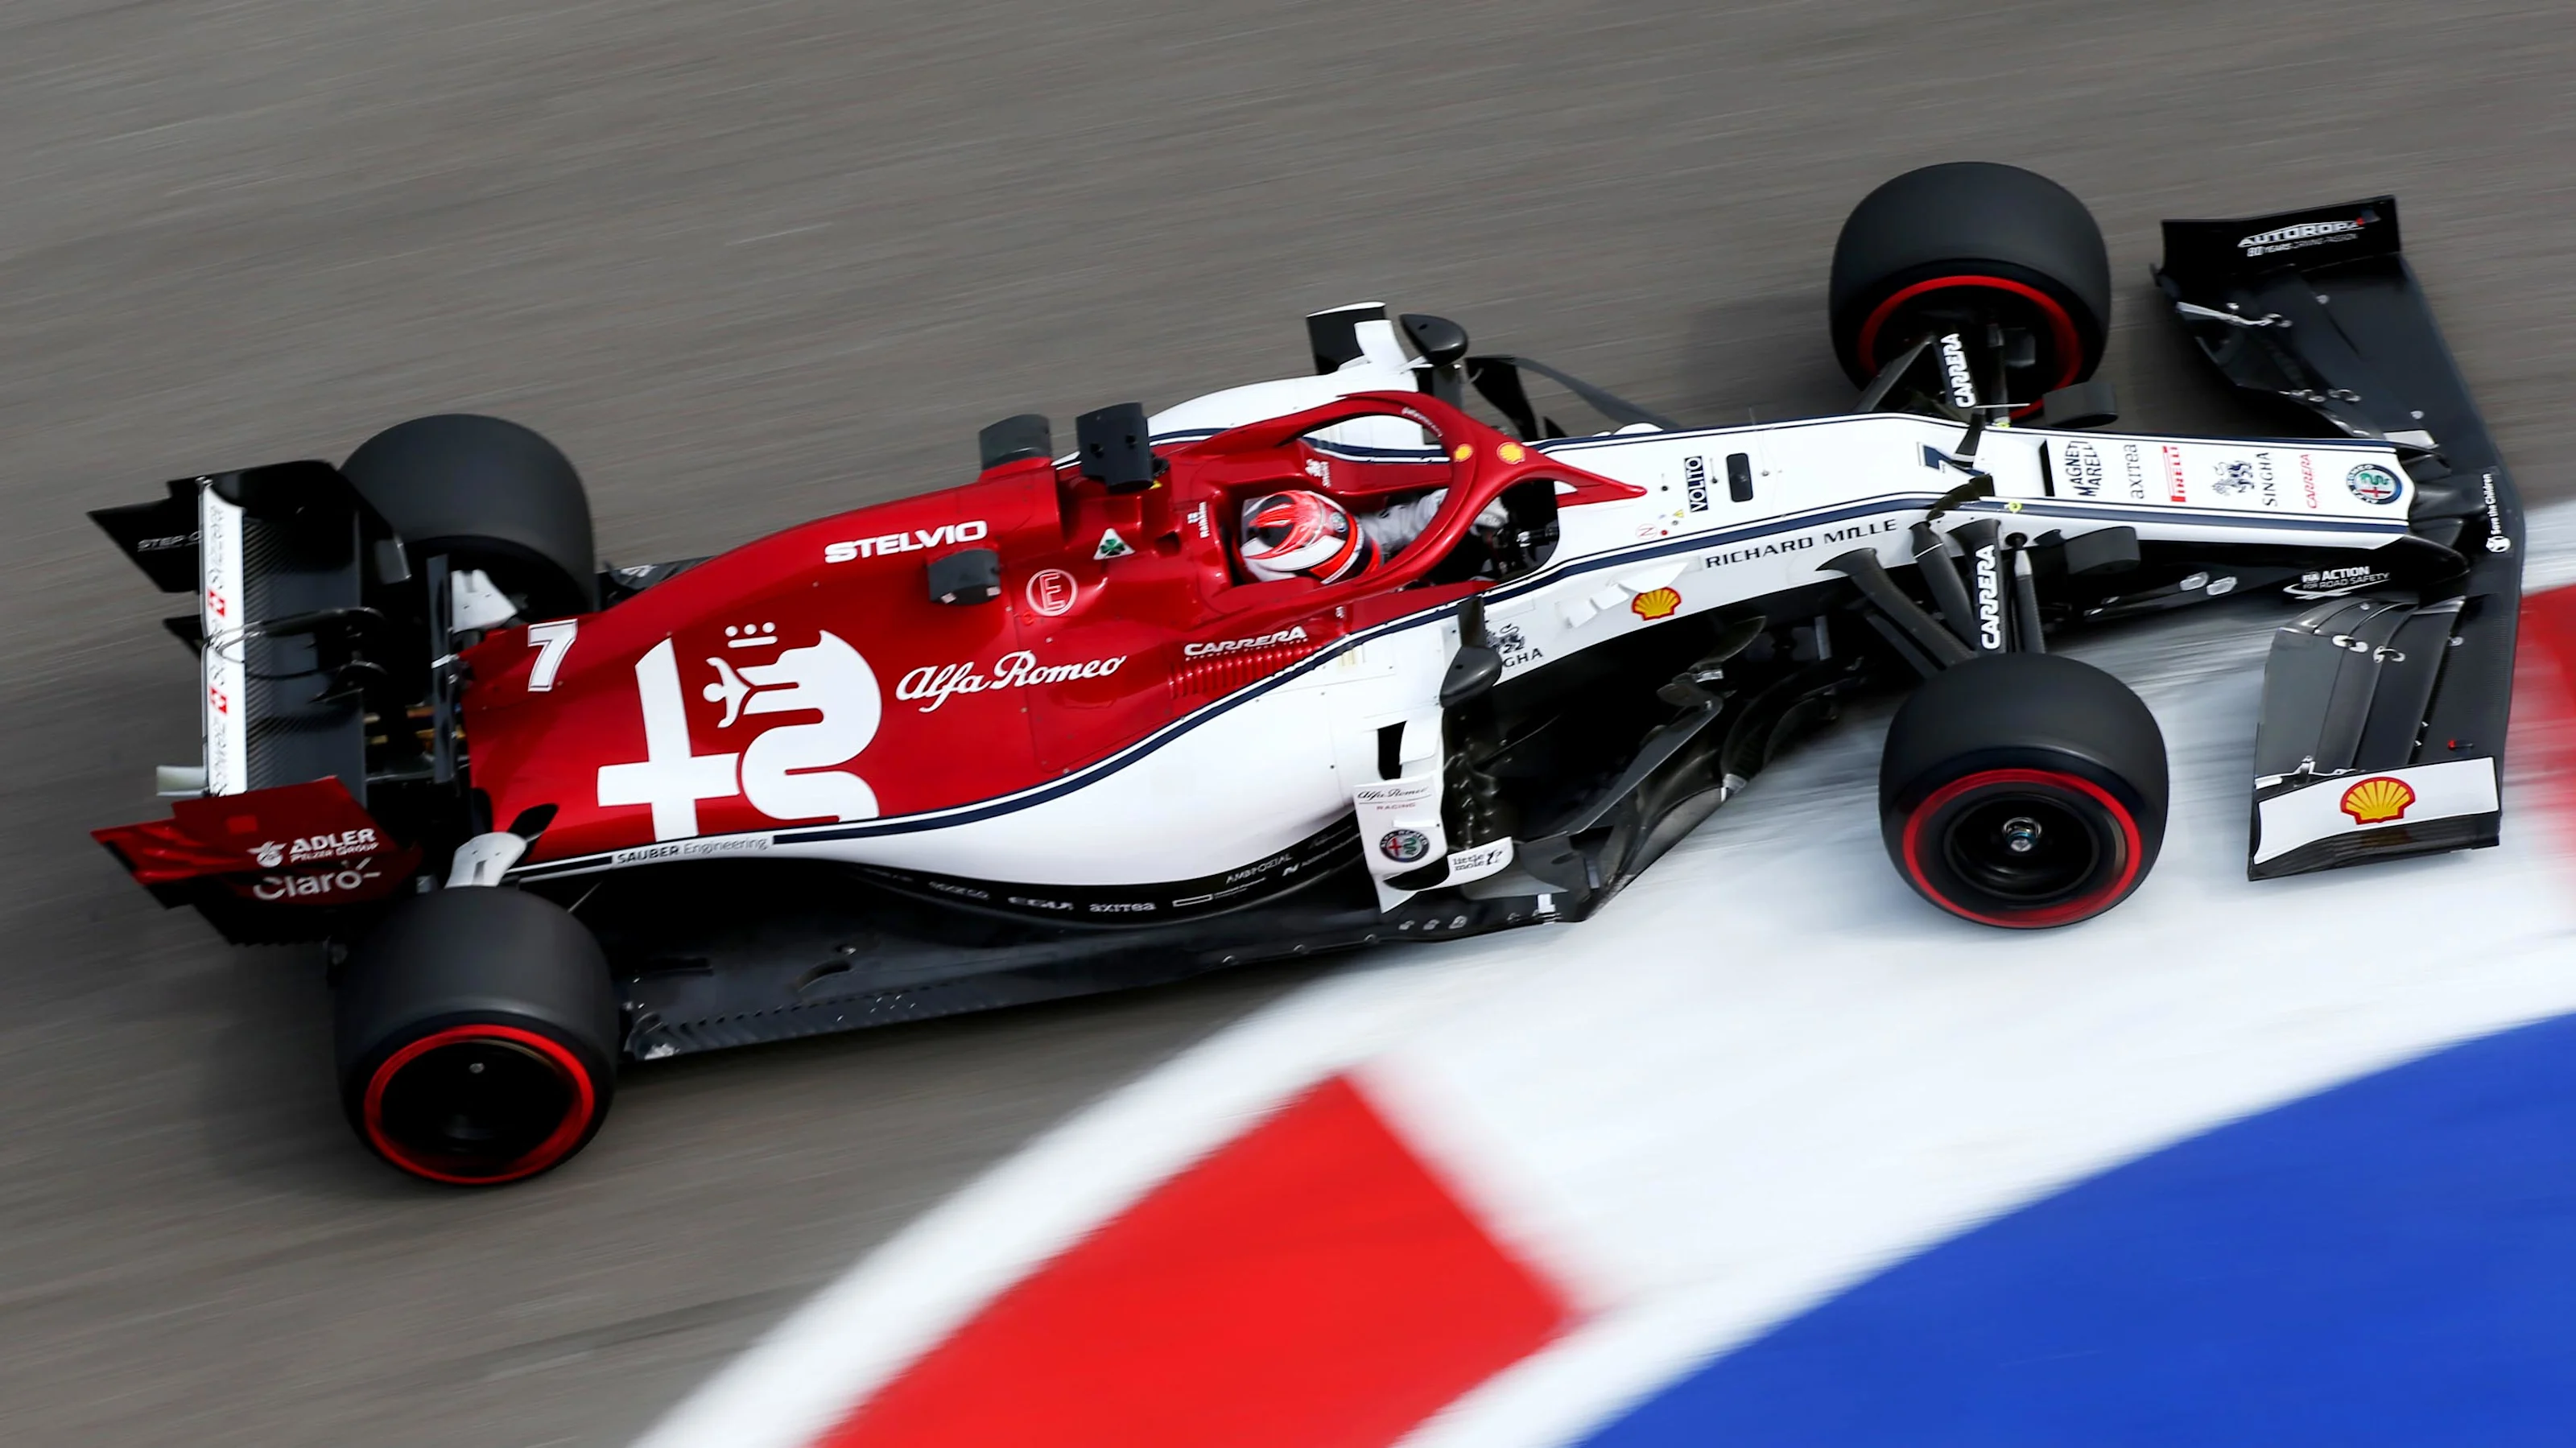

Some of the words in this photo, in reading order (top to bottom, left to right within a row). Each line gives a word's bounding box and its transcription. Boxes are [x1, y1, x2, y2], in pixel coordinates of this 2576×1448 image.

[1940, 333, 1976, 408] CARRERA
[1685, 456, 1707, 513] VOLITO
[2163, 446, 2186, 502] PIRELLI
[2256, 452, 2278, 507] SINGHA
[2300, 453, 2317, 509] CARRERA
[2482, 473, 2496, 505] Children
[2487, 505, 2499, 518] the
[2490, 517, 2502, 535] Save
[824, 520, 989, 564] STELVIO
[1706, 537, 1813, 568] RICHARD
[1823, 518, 1897, 545] MILLE
[2319, 579, 2348, 589] ROAD
[2349, 572, 2391, 585] SAFETY
[2322, 566, 2371, 582] ACTION
[1975, 544, 2001, 650] CARRERA
[527, 618, 578, 692] 7
[1184, 625, 1307, 657] CARRERA
[895, 661, 992, 713] Alfa
[989, 650, 1127, 691] Romeo
[1357, 790, 1386, 802] Alfa
[1387, 786, 1430, 798] Romeo
[1376, 802, 1417, 811] RACING
[290, 828, 377, 855] ADLER
[336, 842, 380, 856] GROUP
[617, 845, 679, 864] SAUBER
[684, 837, 769, 855] Engineering
[1453, 853, 1484, 865] little
[253, 864, 372, 901] Claro
[1089, 902, 1157, 913] axitea
